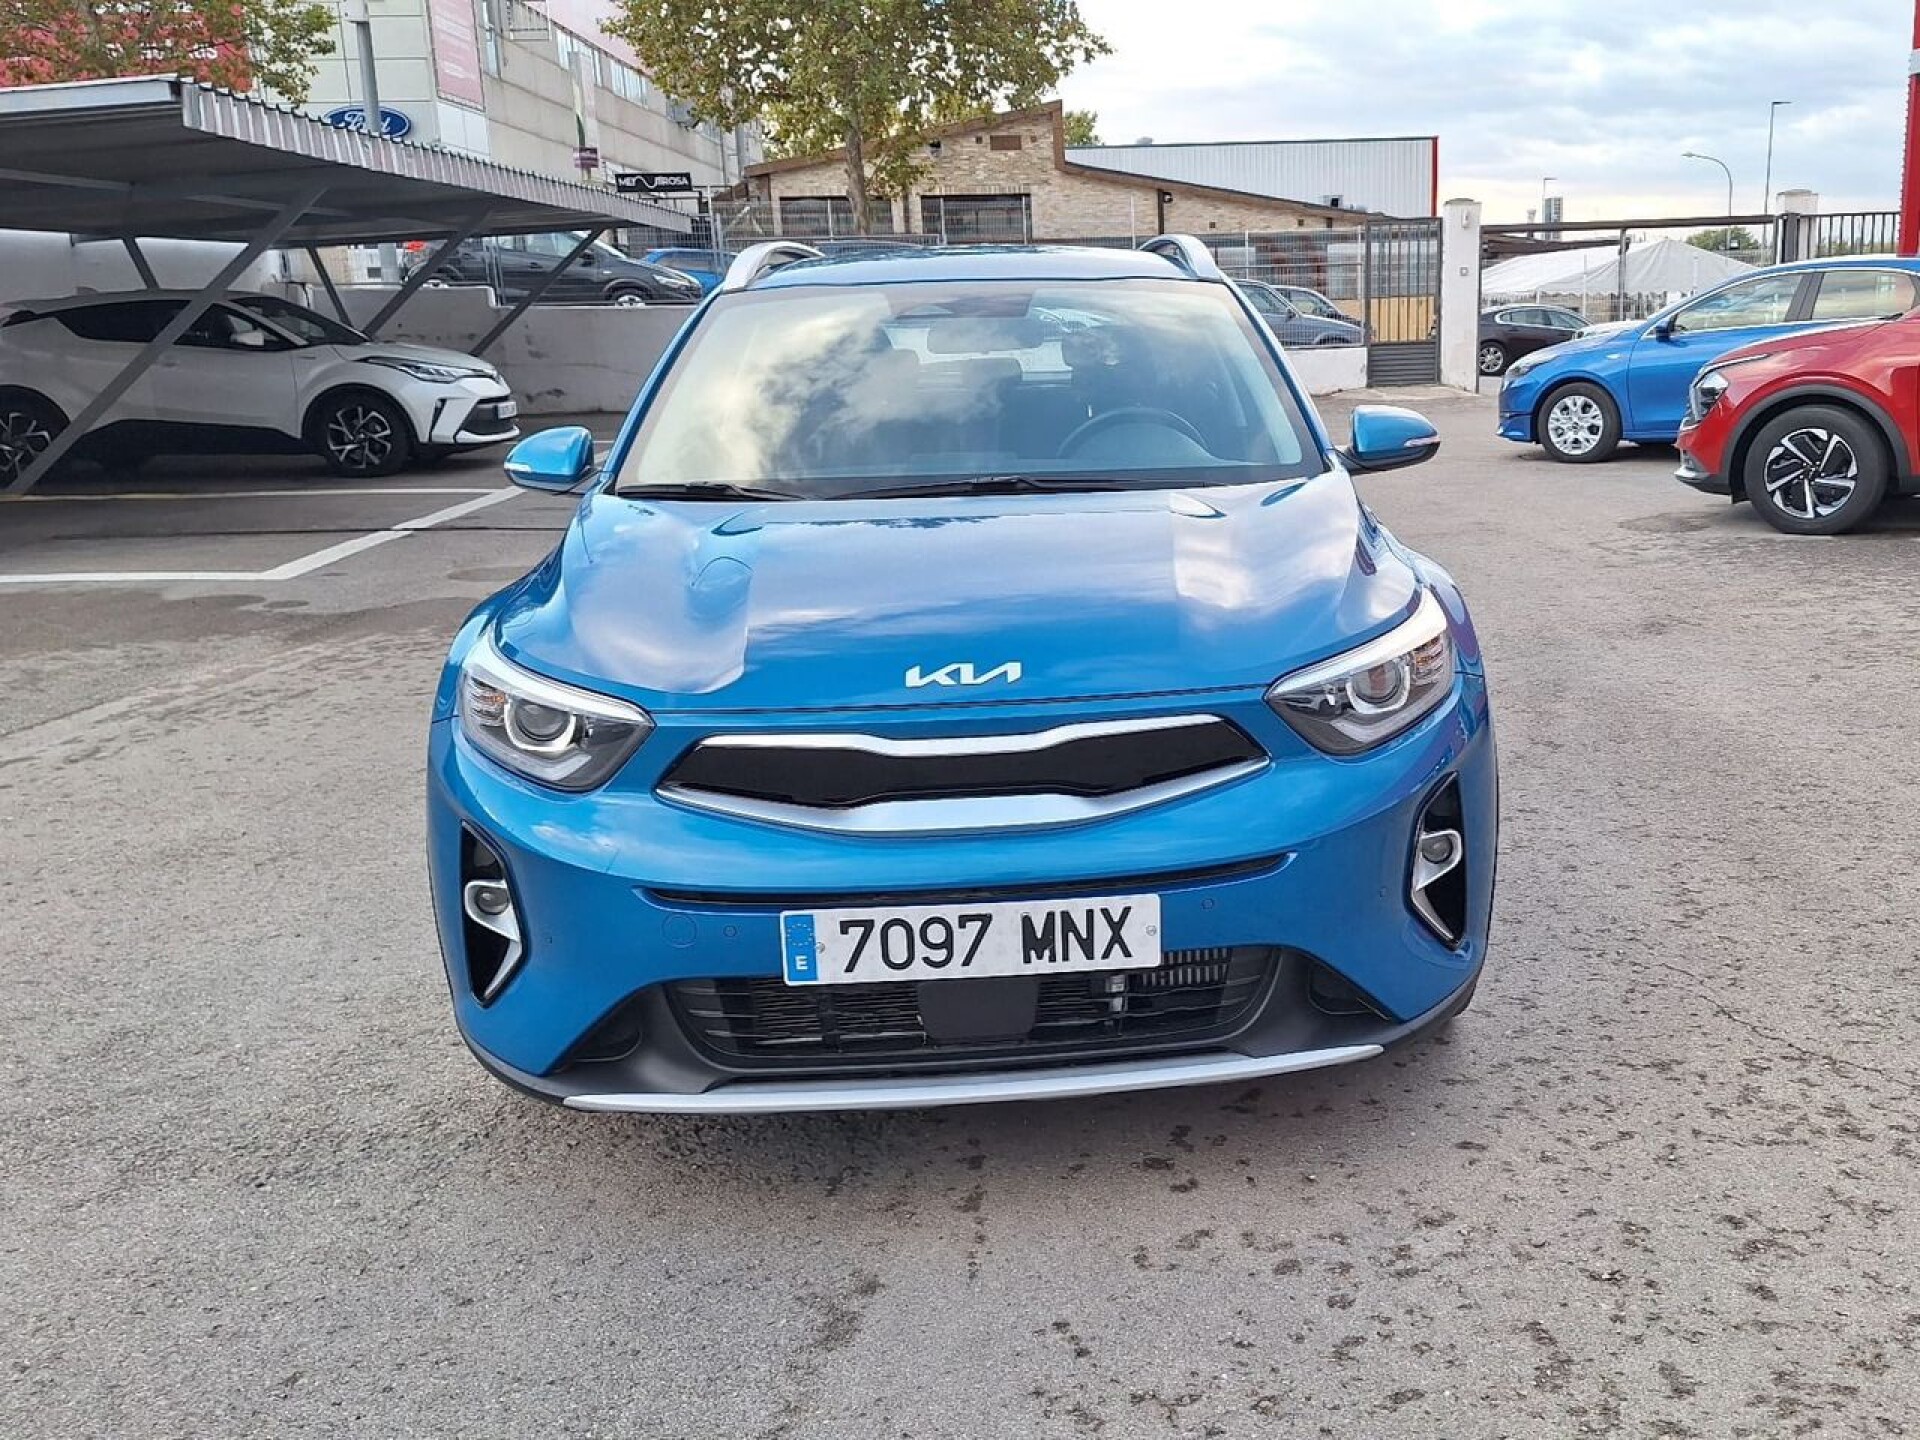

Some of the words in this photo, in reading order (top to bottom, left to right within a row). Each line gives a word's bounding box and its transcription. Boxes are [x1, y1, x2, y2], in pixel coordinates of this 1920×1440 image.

[839, 913, 993, 973] 7097
[1021, 905, 1133, 964] MNX
[795, 956, 808, 970] E
